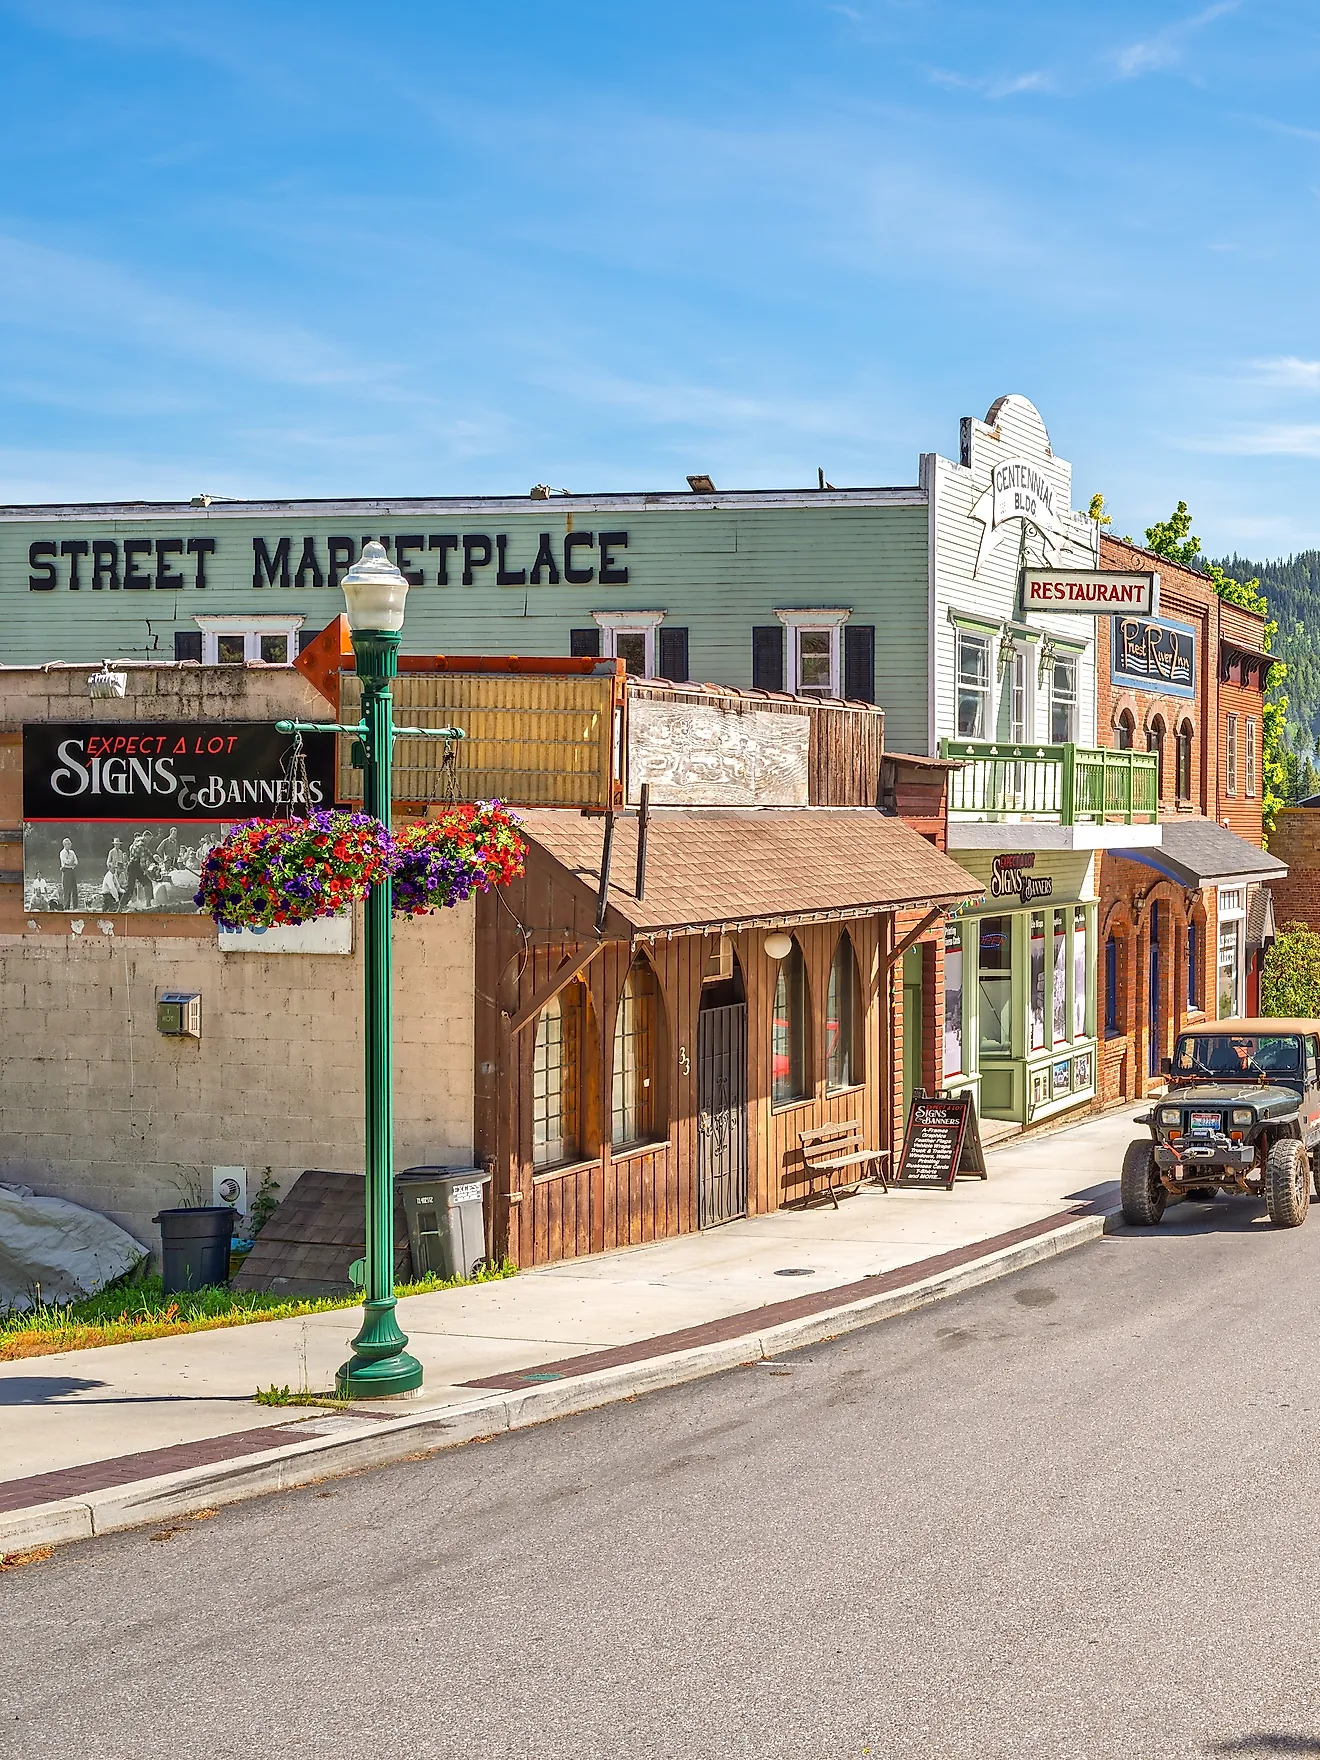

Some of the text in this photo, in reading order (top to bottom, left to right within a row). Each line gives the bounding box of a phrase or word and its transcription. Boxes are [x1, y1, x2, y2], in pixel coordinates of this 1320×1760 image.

[996, 464, 1054, 517] CENTENNIAL
[29, 539, 215, 591] STREET
[1030, 581, 1145, 603] RESTAURANT
[1121, 619, 1146, 669] Priest
[1145, 624, 1174, 679] River
[87, 736, 167, 762] EXPECT
[195, 736, 239, 754] LOT
